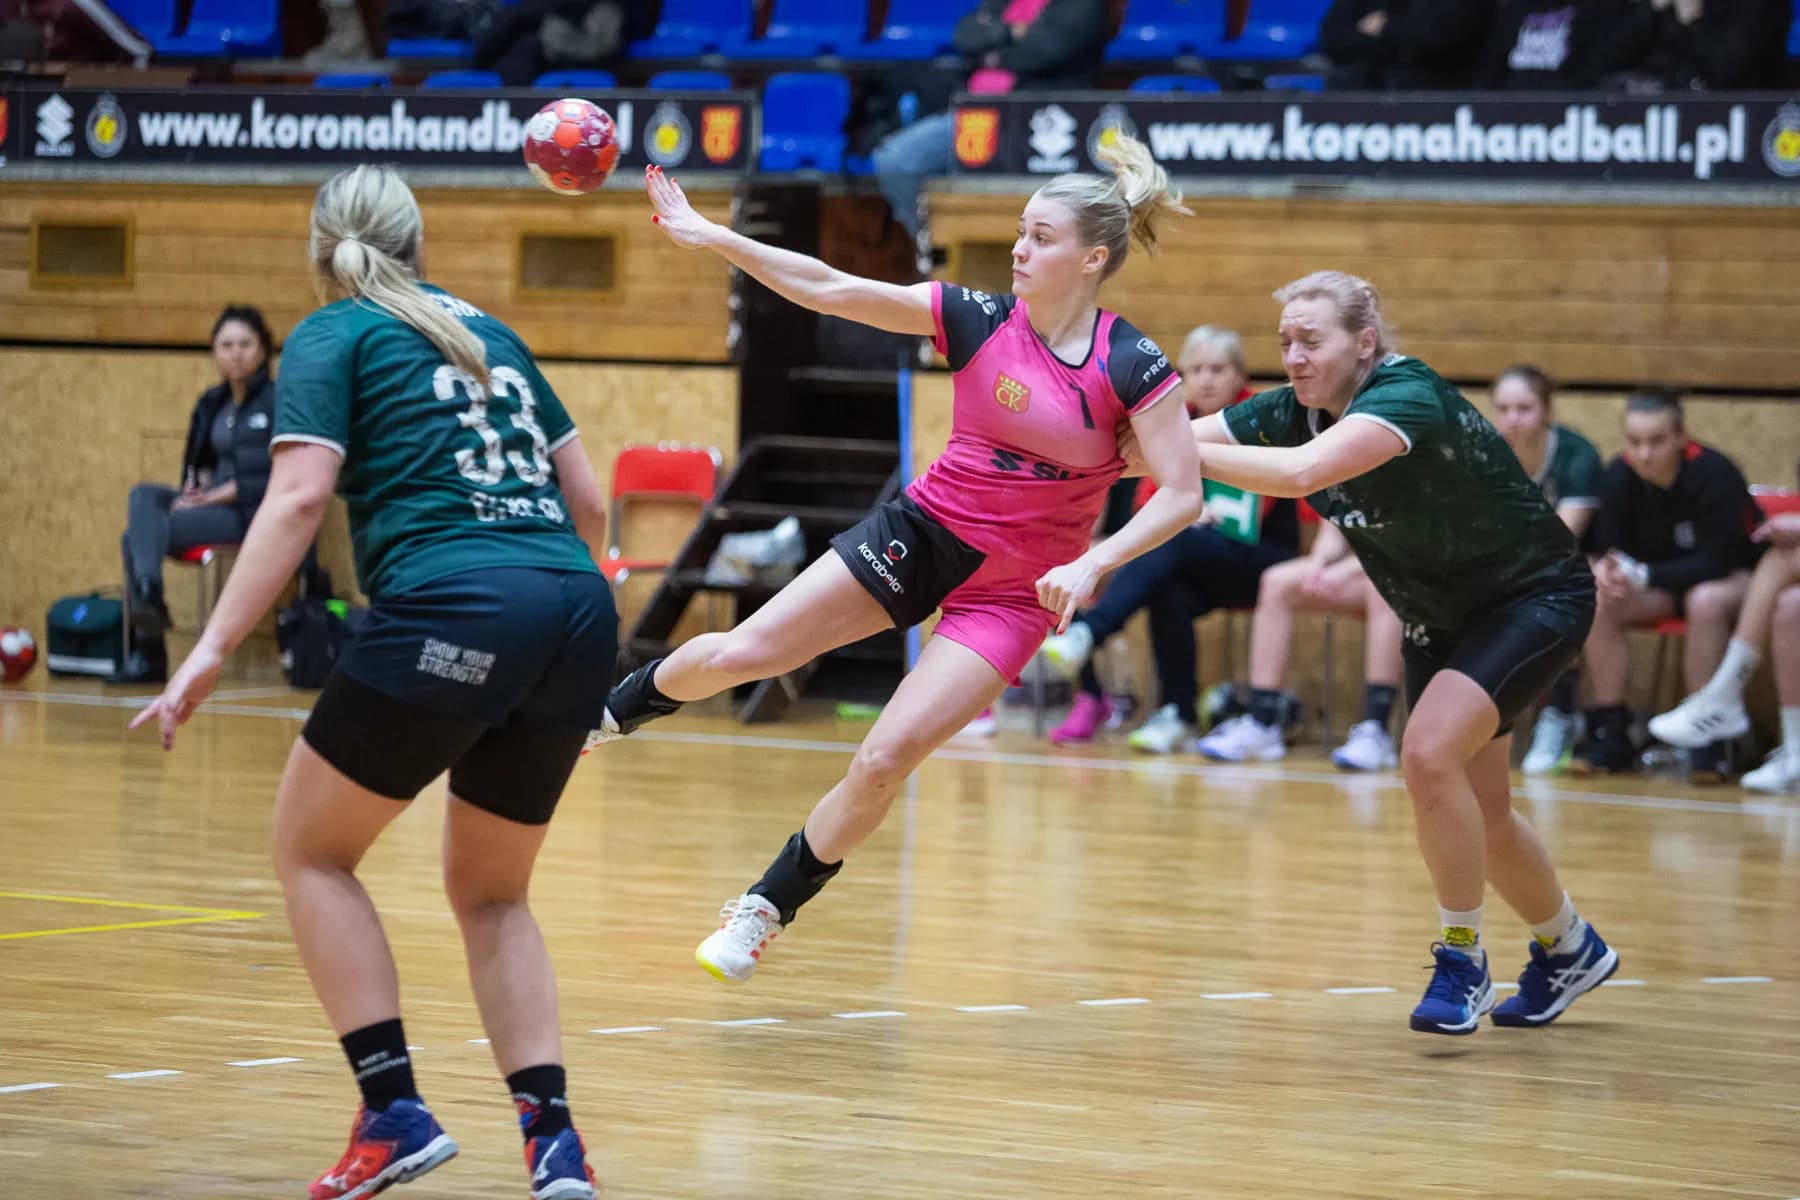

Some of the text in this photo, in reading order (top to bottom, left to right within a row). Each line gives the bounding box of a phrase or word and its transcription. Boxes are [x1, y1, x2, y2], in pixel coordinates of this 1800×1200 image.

[138, 97, 635, 155] www.koronahandbl
[1149, 104, 1746, 179] www.koronahandball.pl
[432, 364, 553, 487] 33
[996, 387, 1022, 412] CK
[857, 541, 902, 593] karabela
[422, 638, 461, 661] SHOW
